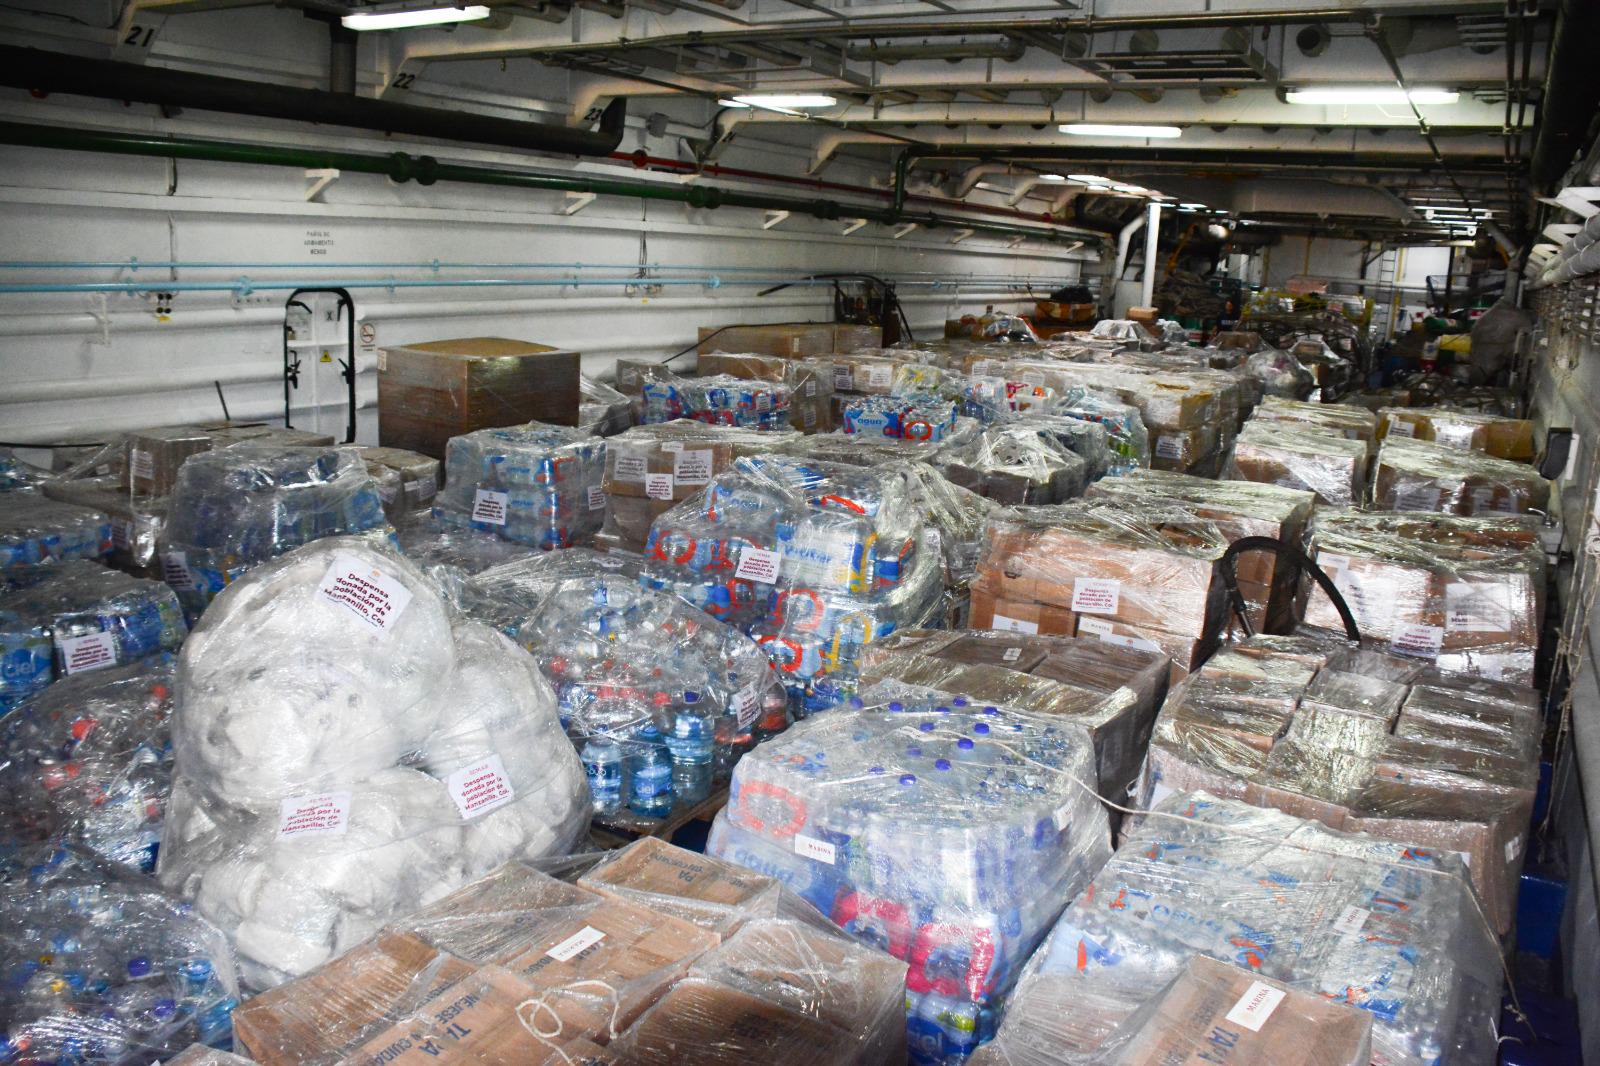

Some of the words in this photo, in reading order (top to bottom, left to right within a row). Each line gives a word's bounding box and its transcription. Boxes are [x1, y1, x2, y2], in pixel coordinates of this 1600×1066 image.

[124, 25, 155, 47] 21
[391, 72, 416, 89] 22
[336, 577, 368, 595] donada
[368, 593, 384, 604] por
[384, 602, 392, 612] la
[348, 573, 389, 598] Despensa
[324, 588, 370, 617] Manzanillo,
[333, 585, 375, 608] población
[375, 606, 386, 617] de
[461, 783, 485, 796] donada
[486, 779, 495, 787] por
[463, 772, 494, 788] Despensa
[1246, 988, 1270, 1012] MARINA
